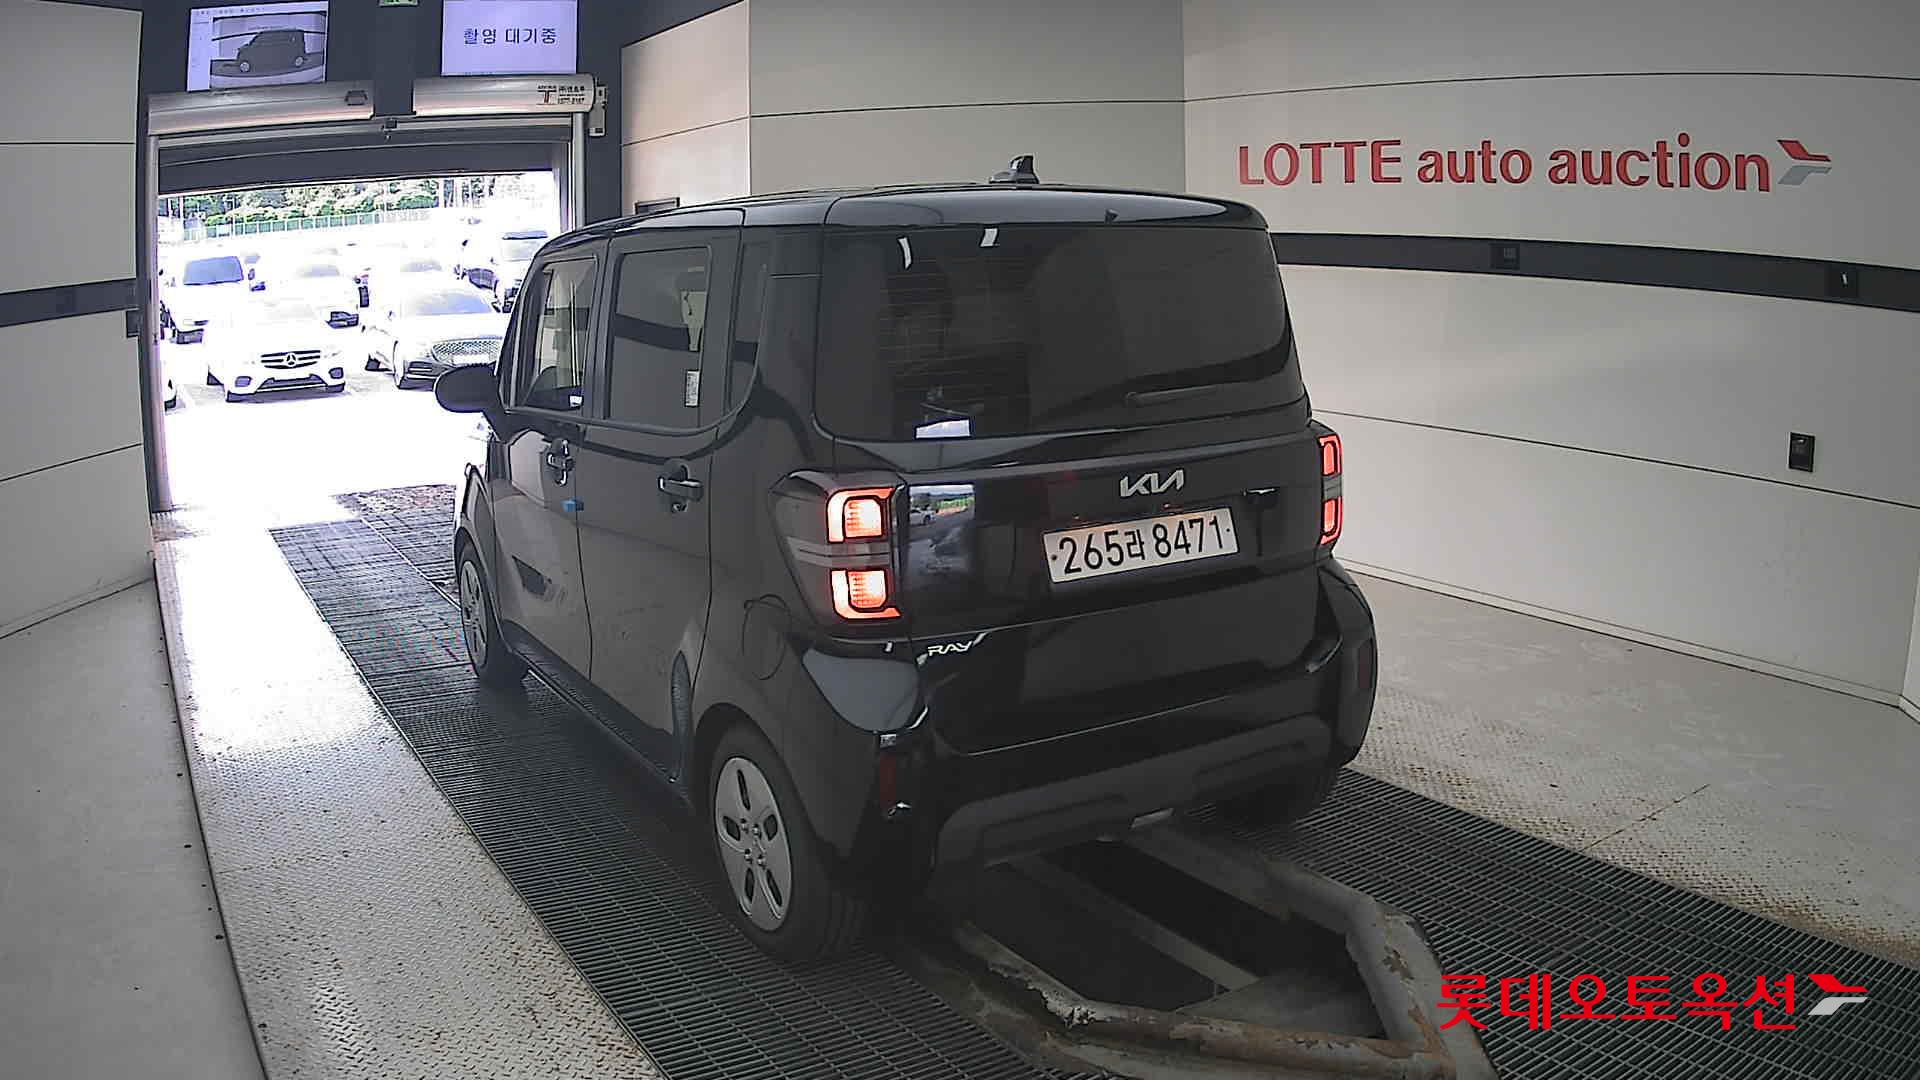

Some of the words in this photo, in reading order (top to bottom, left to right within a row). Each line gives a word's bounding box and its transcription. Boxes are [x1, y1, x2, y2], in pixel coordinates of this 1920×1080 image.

[463, 27, 497, 45] 촬영
[505, 27, 557, 45] 대기중
[1239, 139, 1402, 186] LOTTE
[1417, 140, 1533, 184] auto
[1549, 132, 1771, 193] auction
[1119, 469, 1185, 498] KIA
[1058, 528, 1147, 575] 265라
[1152, 515, 1224, 559] 8471
[927, 639, 974, 657] RAY
